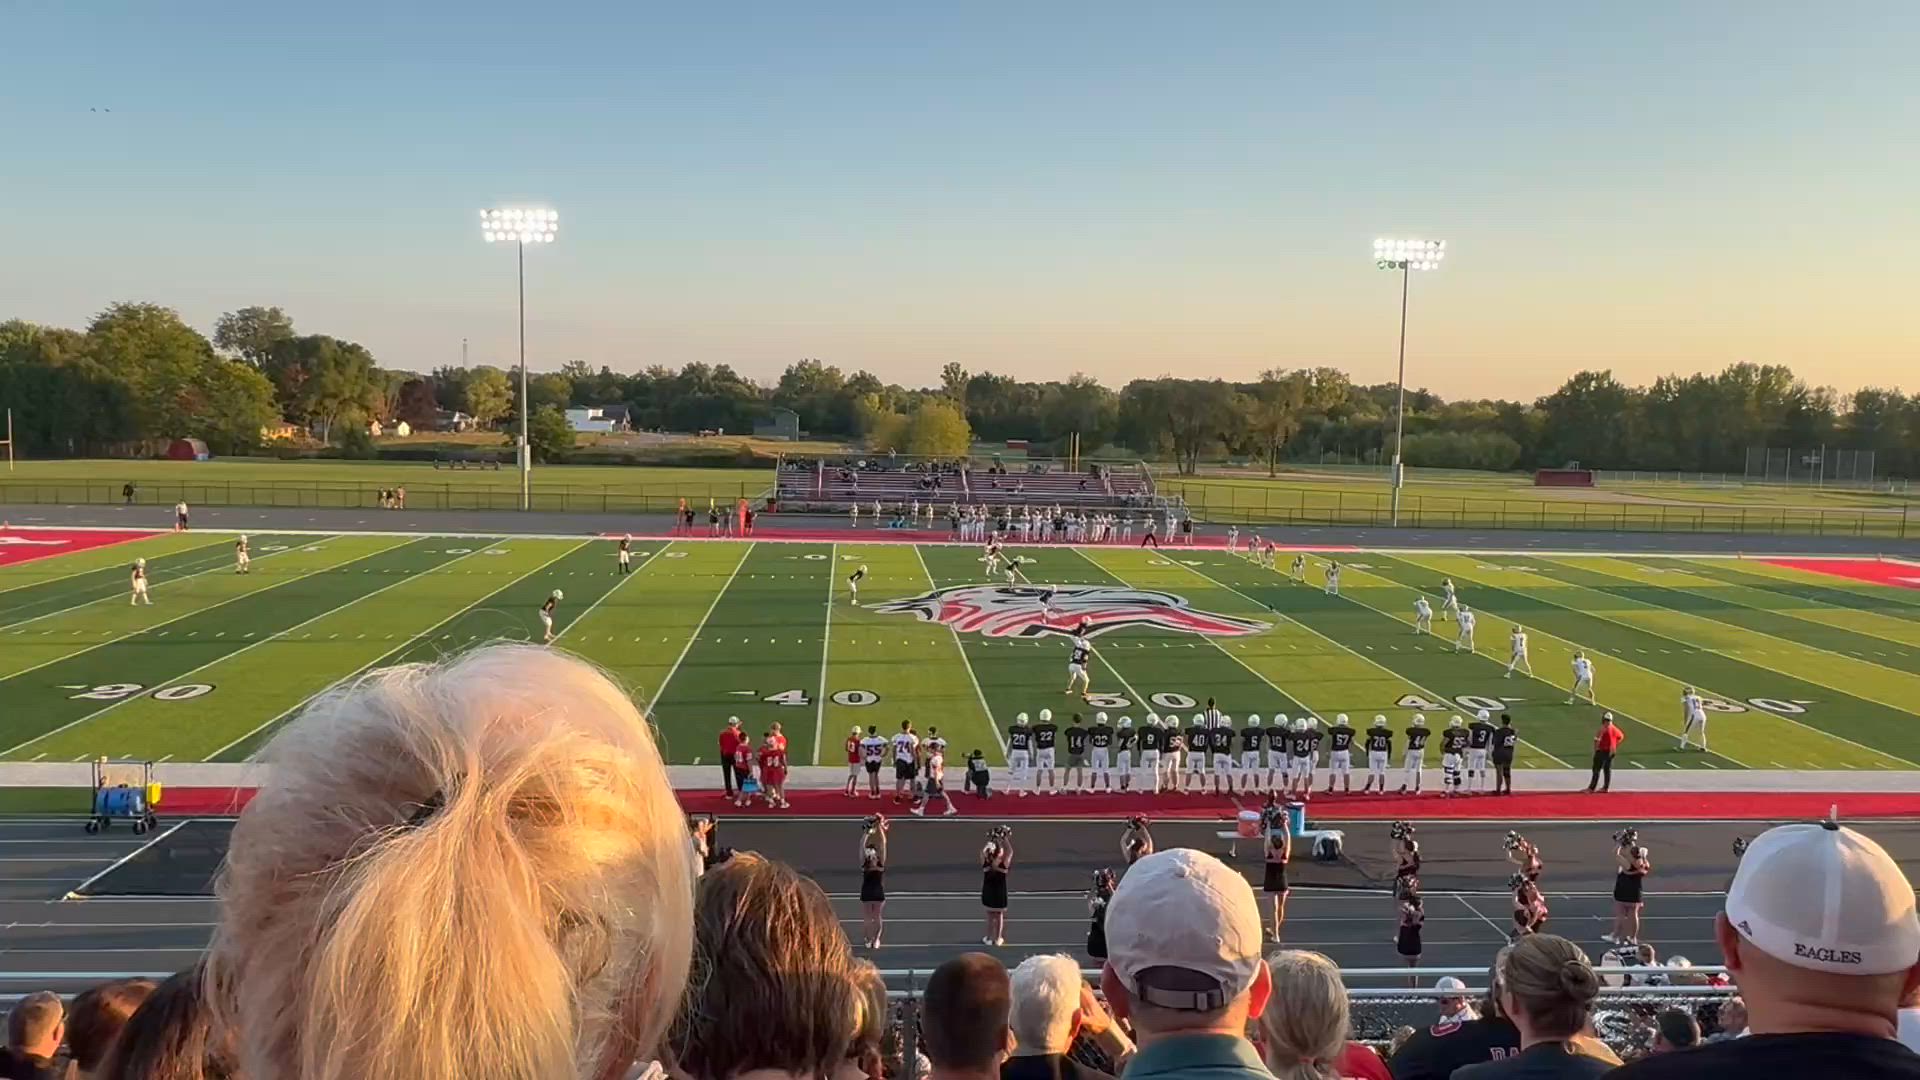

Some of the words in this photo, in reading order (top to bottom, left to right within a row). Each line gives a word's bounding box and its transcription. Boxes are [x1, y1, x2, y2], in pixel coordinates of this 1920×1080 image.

[1012, 734, 1026, 746] 20
[1039, 731, 1053, 741] 22
[1070, 735, 1082, 748] 14
[1146, 734, 1155, 745] 9
[1192, 734, 1205, 747] 40
[1215, 735, 1227, 747] 34
[1271, 735, 1282, 747] 10
[1336, 734, 1350, 746] 57
[1373, 736, 1386, 748] 70
[1478, 730, 1487, 742] 3
[866, 744, 882, 756] 55
[897, 740, 911, 753] 74
[1296, 740, 1309, 752] 24
[1794, 943, 1862, 965] EAGLES
